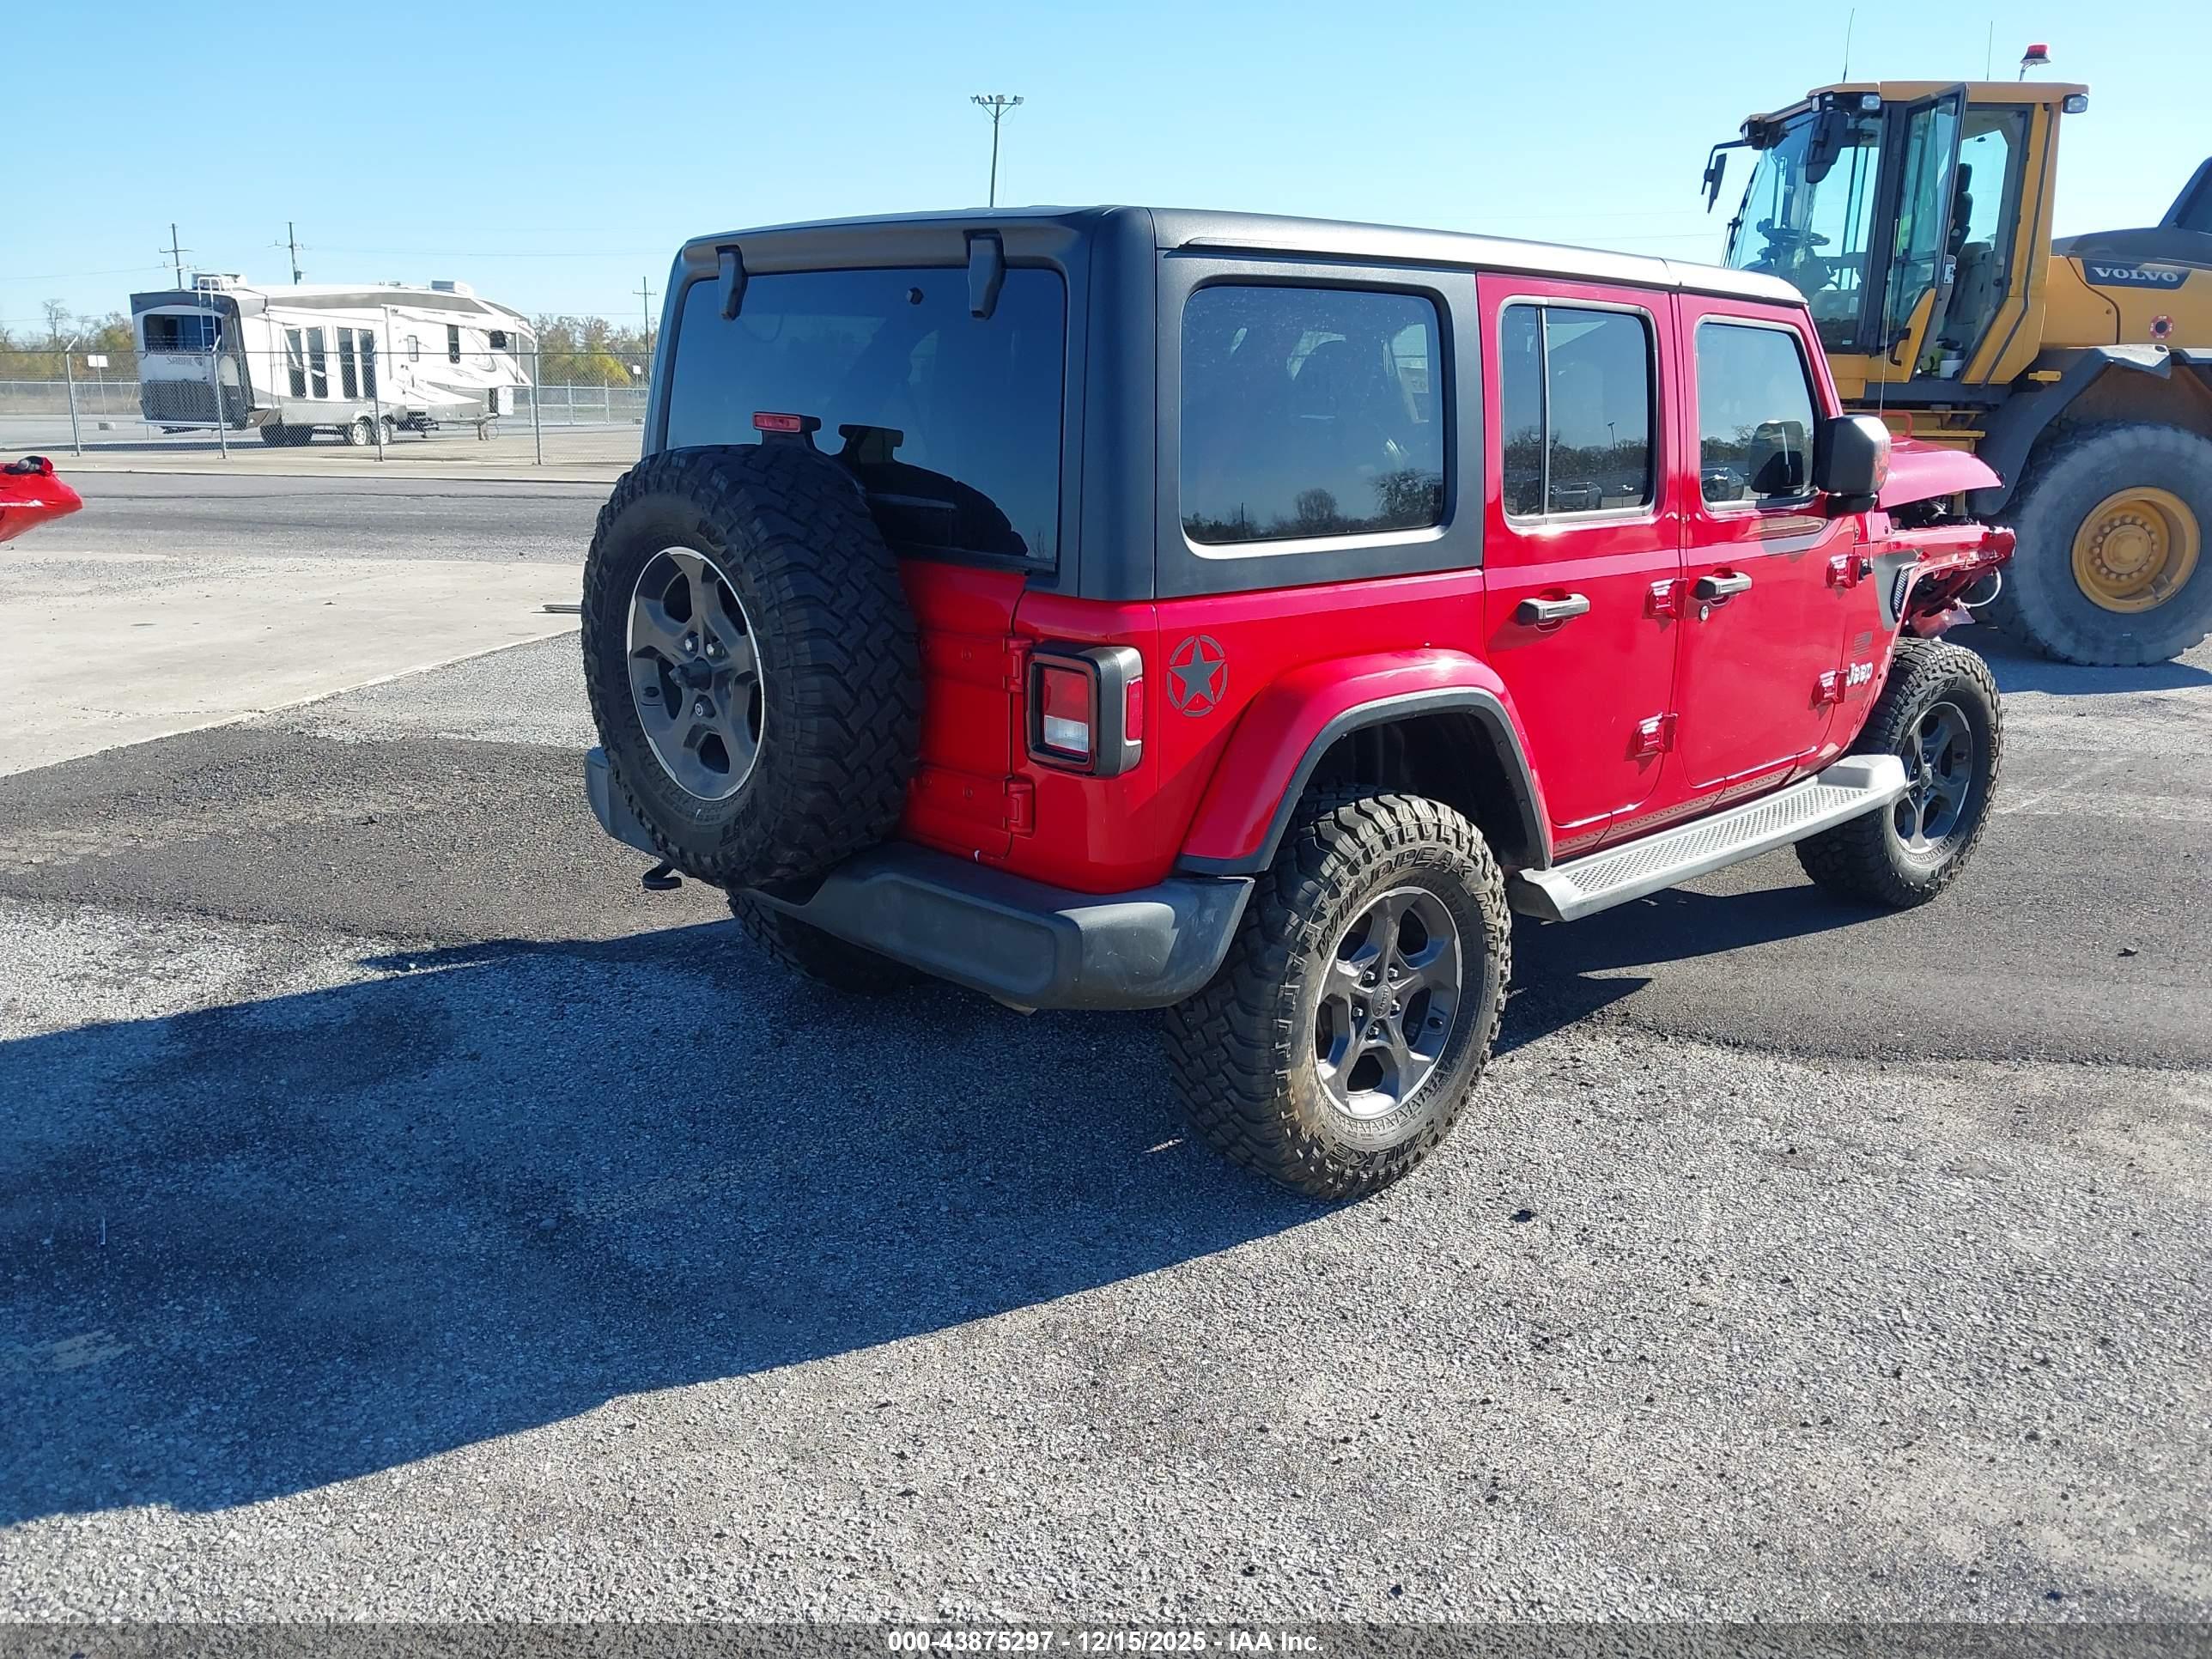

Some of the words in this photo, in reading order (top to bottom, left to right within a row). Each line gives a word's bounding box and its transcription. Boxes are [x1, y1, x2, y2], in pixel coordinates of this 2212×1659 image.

[2092, 266, 2179, 282] VOLVO
[1845, 661, 1874, 688] Jeep
[1316, 847, 1474, 959] WILDPEAK
